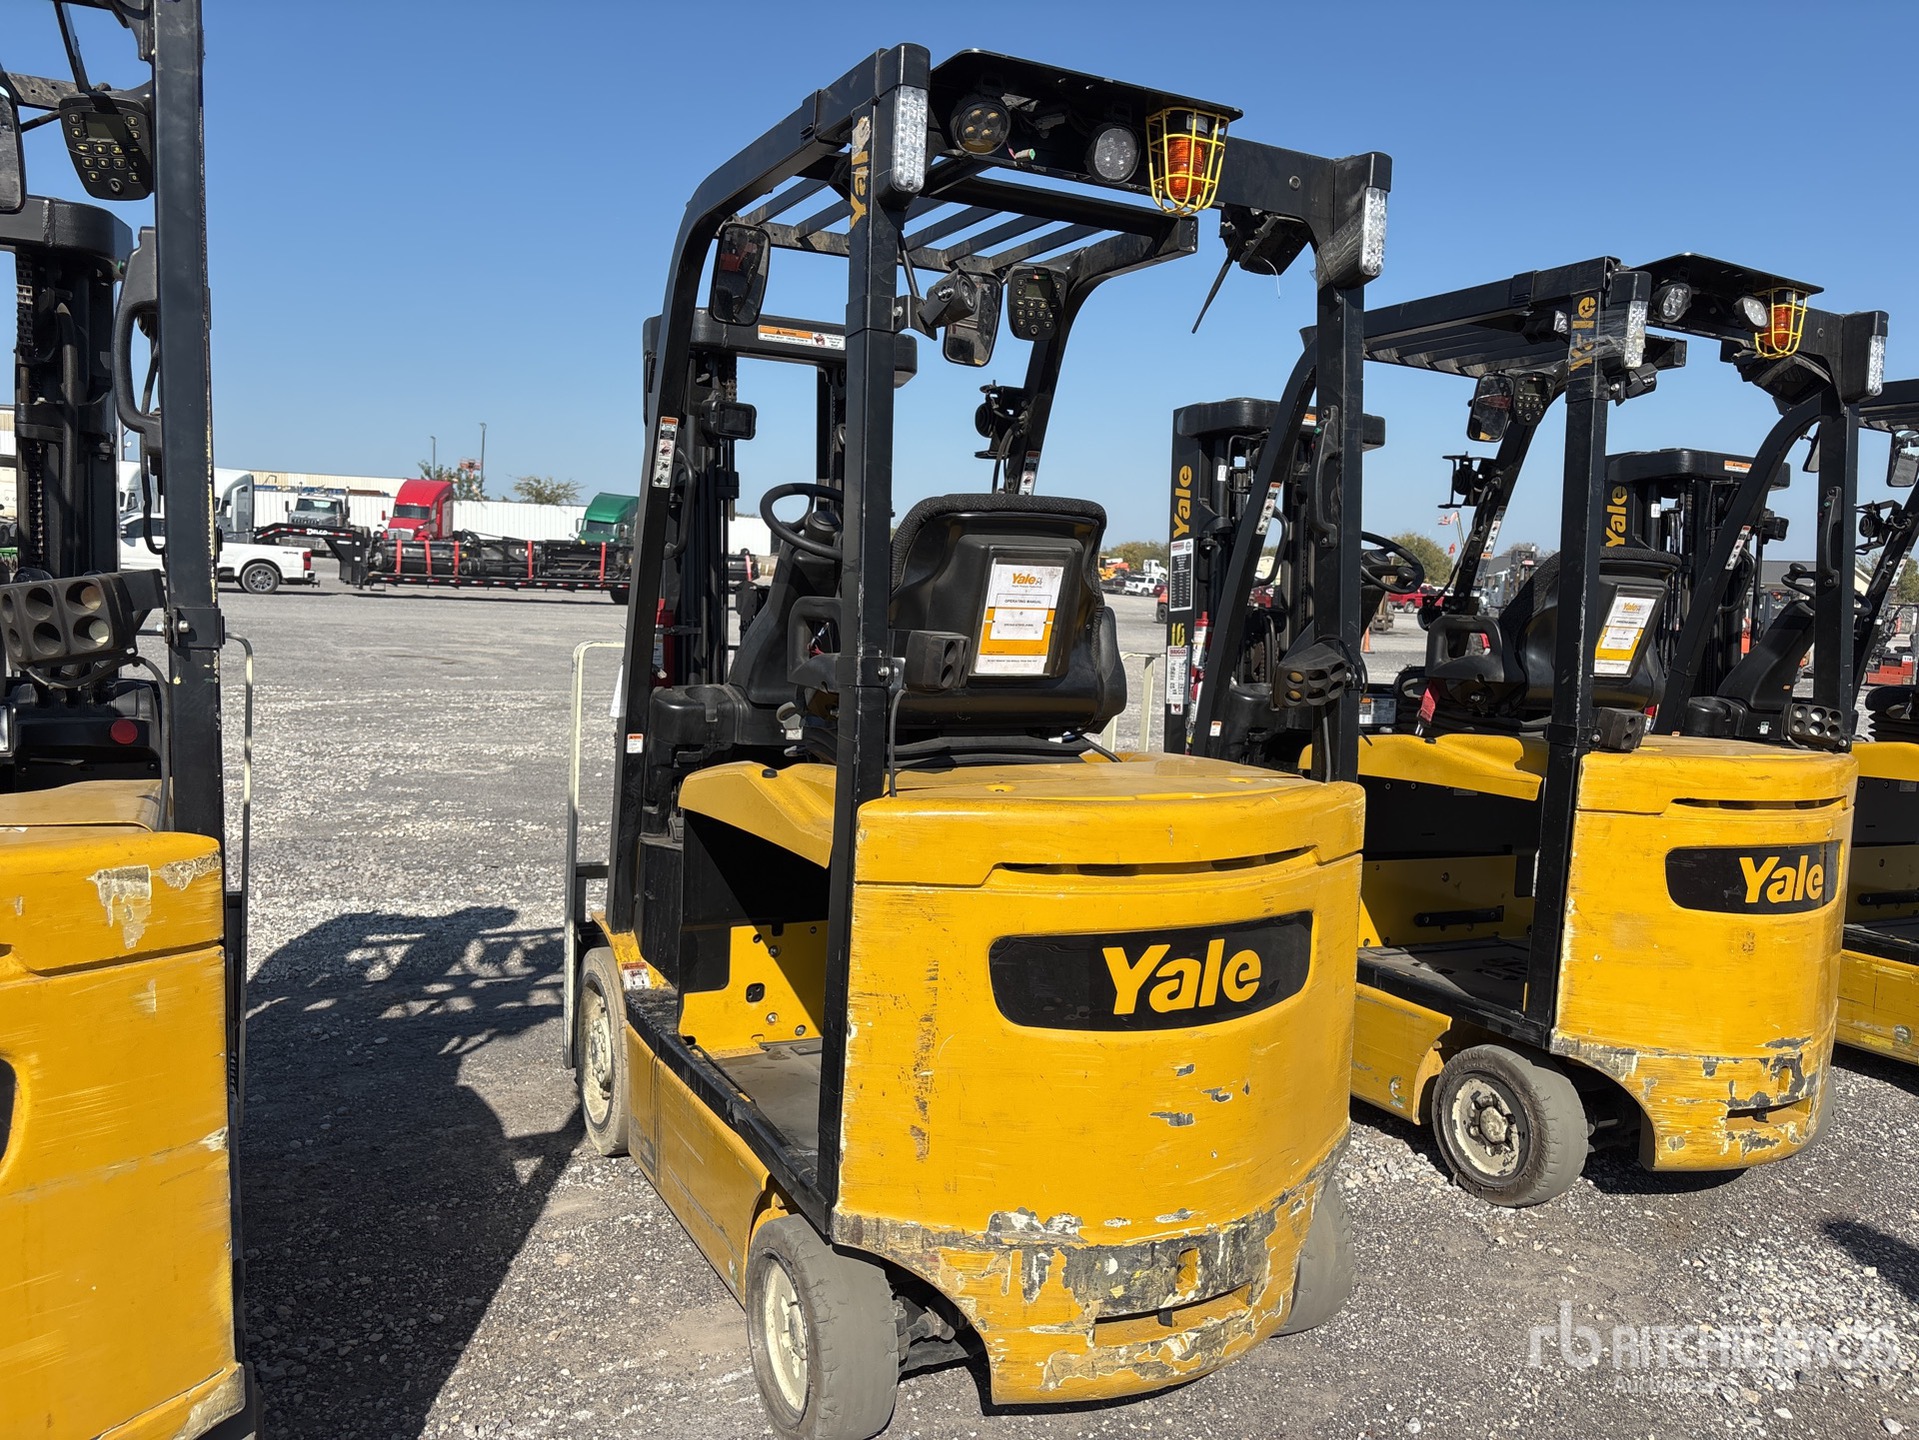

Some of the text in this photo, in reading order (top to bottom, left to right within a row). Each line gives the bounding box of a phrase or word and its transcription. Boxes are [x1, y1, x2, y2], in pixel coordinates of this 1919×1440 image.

[850, 116, 871, 229] Yal
[1173, 465, 1192, 538] Yale
[1605, 486, 1628, 547] Yale
[1012, 573, 1036, 585] Yale
[1739, 855, 1824, 904] Yale
[1102, 938, 1262, 1016] Yale
